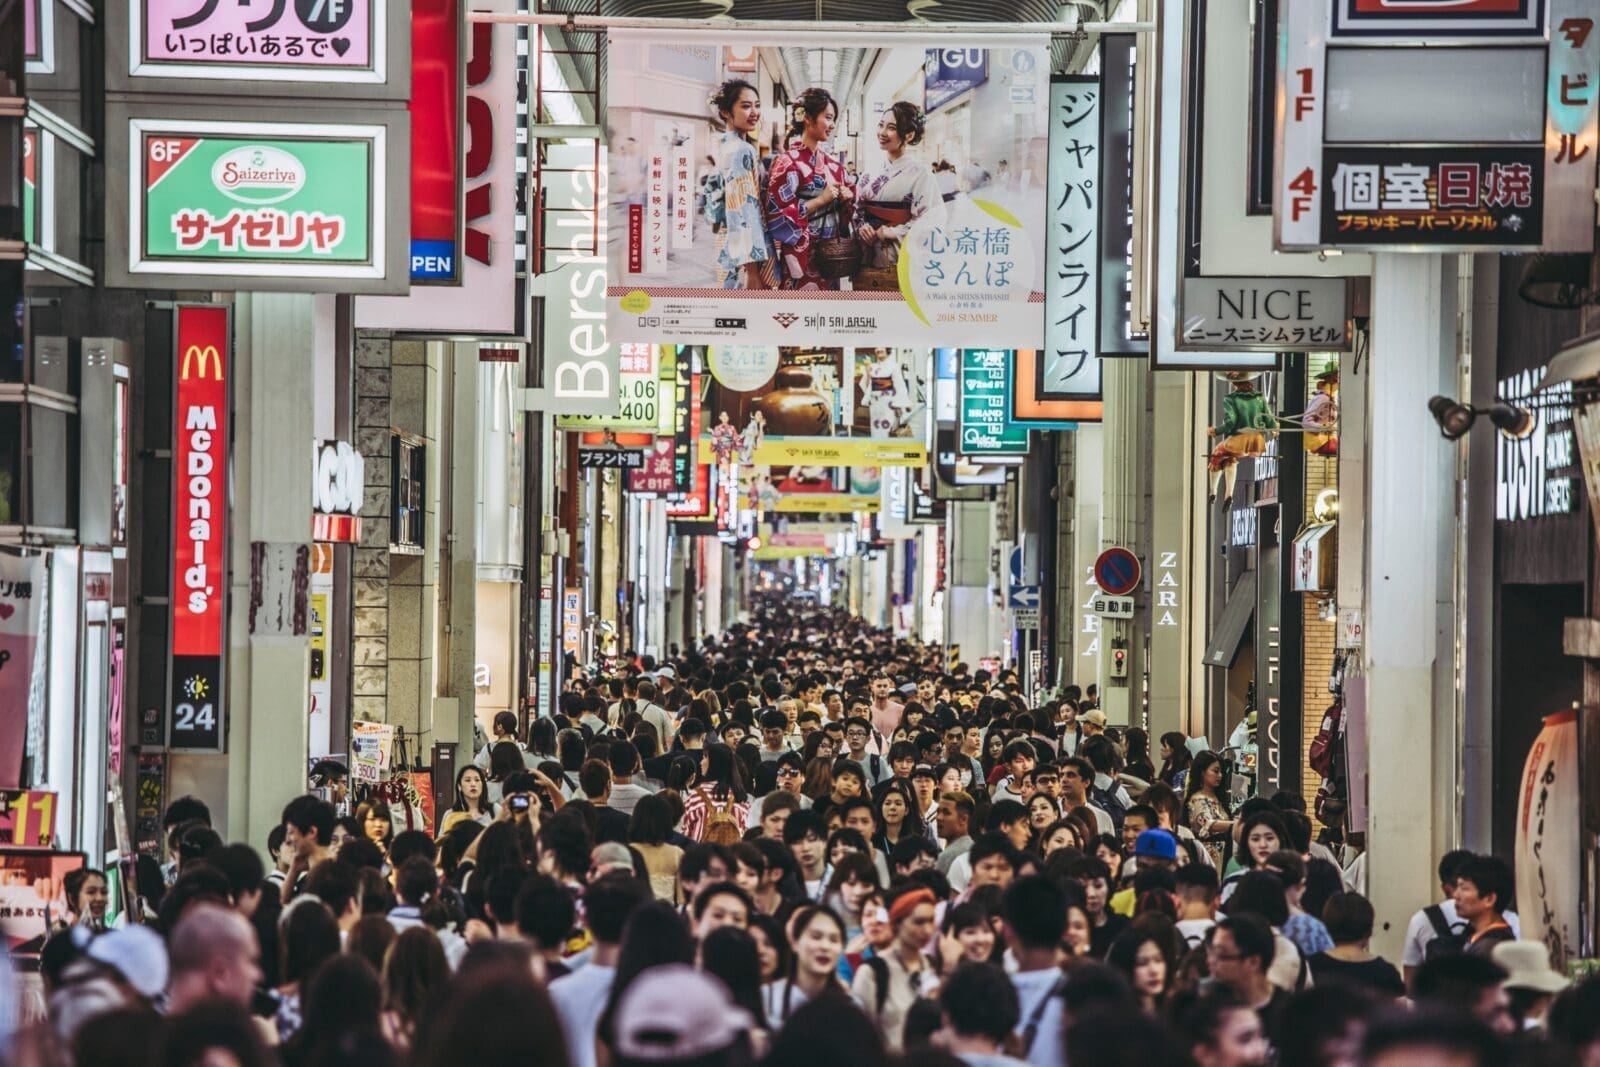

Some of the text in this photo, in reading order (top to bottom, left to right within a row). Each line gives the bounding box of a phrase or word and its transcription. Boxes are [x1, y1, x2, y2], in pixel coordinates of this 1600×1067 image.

[165, 33, 328, 57] いっぱいあるで
[1295, 67, 1315, 122] 1F
[149, 141, 181, 162] 6F
[221, 162, 298, 186] Saizeriya
[1332, 162, 1531, 211] 個室日焼
[1289, 166, 1317, 222] 4F
[174, 211, 342, 251] サイゼリヤ
[922, 226, 1011, 256] 心斎橋
[1055, 91, 1098, 382] ジャパンライフ
[554, 164, 609, 399] Bershka
[923, 259, 1014, 287] さんぽ
[1216, 288, 1314, 321] NICE
[1189, 326, 1342, 344] ニースニシムラビル
[634, 381, 655, 398] 06
[185, 405, 217, 614] McDonald's
[1157, 552, 1178, 626] ZARA
[1094, 600, 1134, 614] 自動車
[174, 703, 216, 731] 24
